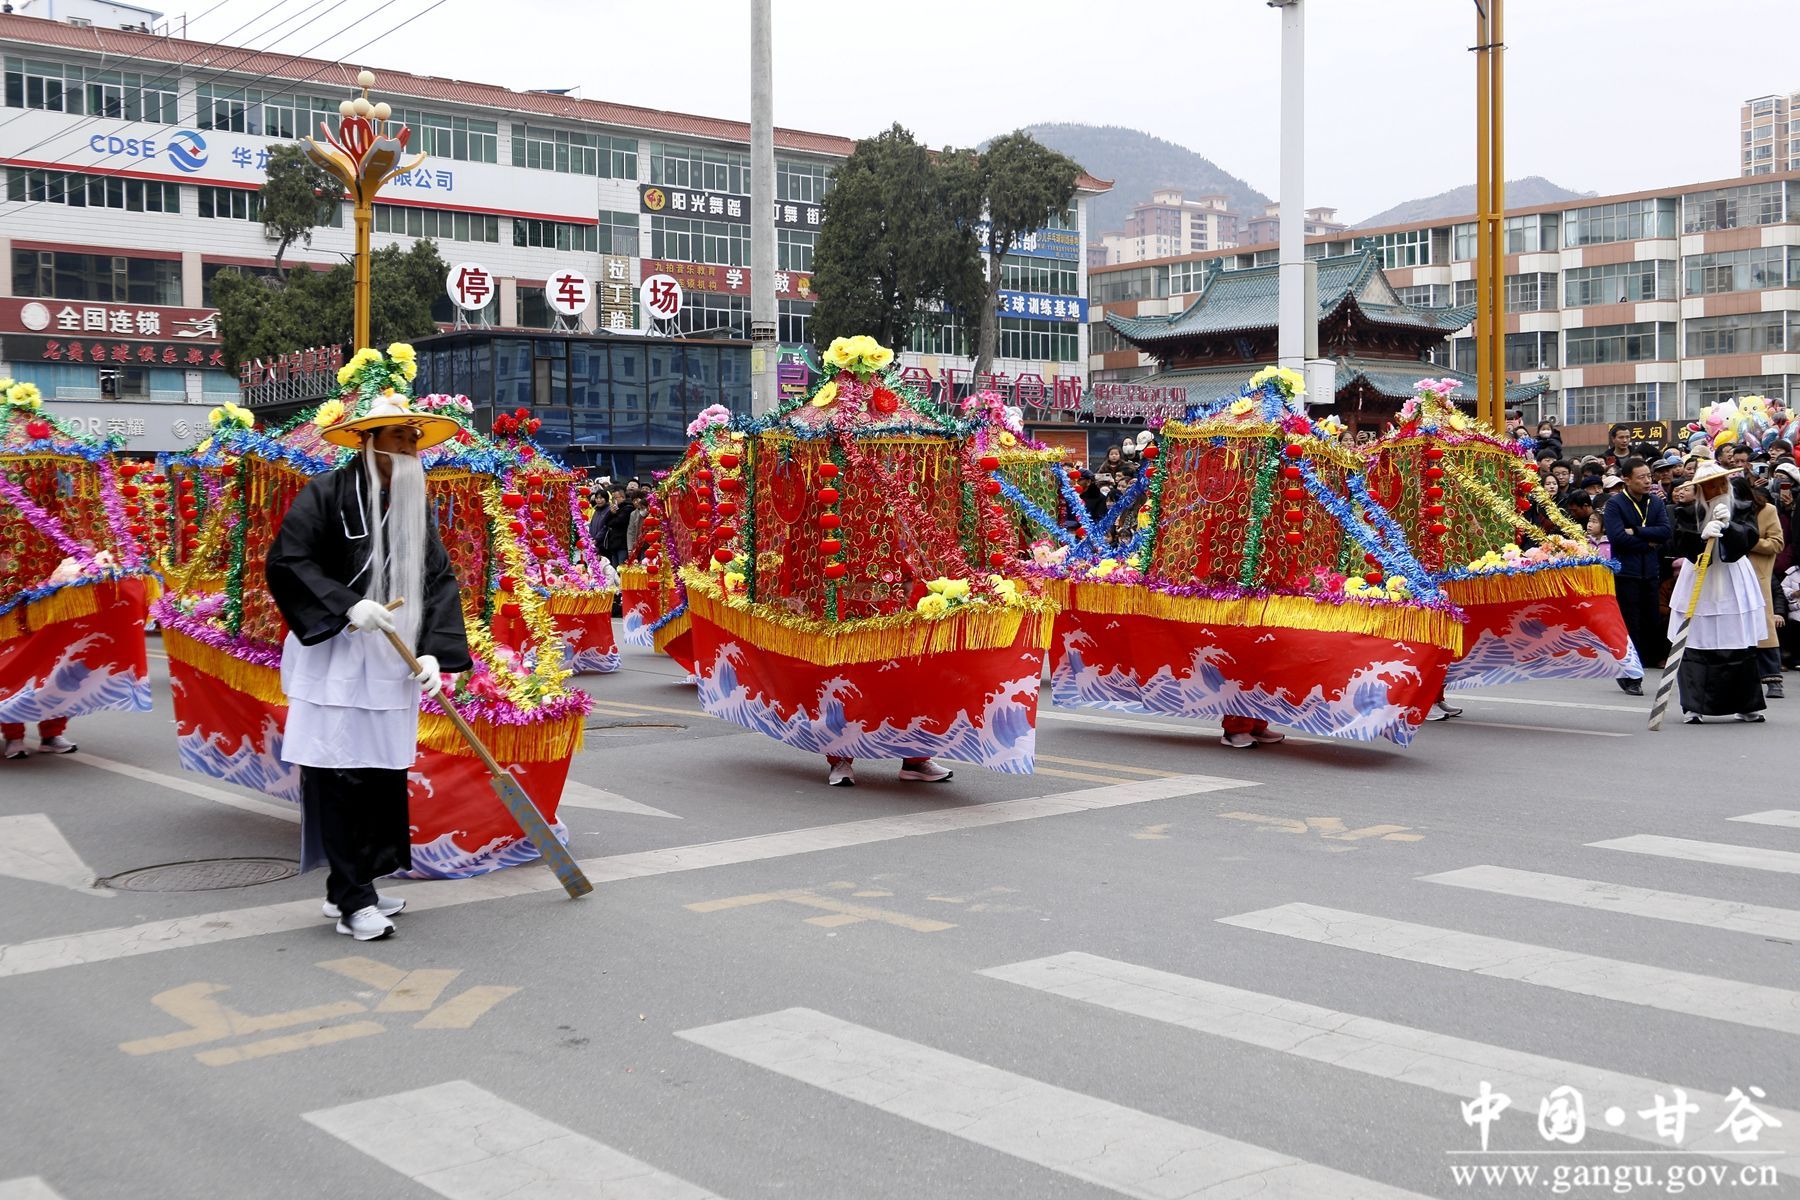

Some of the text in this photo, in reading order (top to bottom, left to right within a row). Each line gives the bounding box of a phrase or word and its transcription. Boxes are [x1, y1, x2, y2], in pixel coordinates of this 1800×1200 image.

[90, 134, 156, 159] CDSE
[671, 191, 742, 218] 阳光舞蹈
[655, 262, 716, 277] 九拍音乐教育
[456, 268, 680, 314] 停车场
[55, 306, 161, 336] 全国连锁
[106, 417, 145, 437] 荣耀
